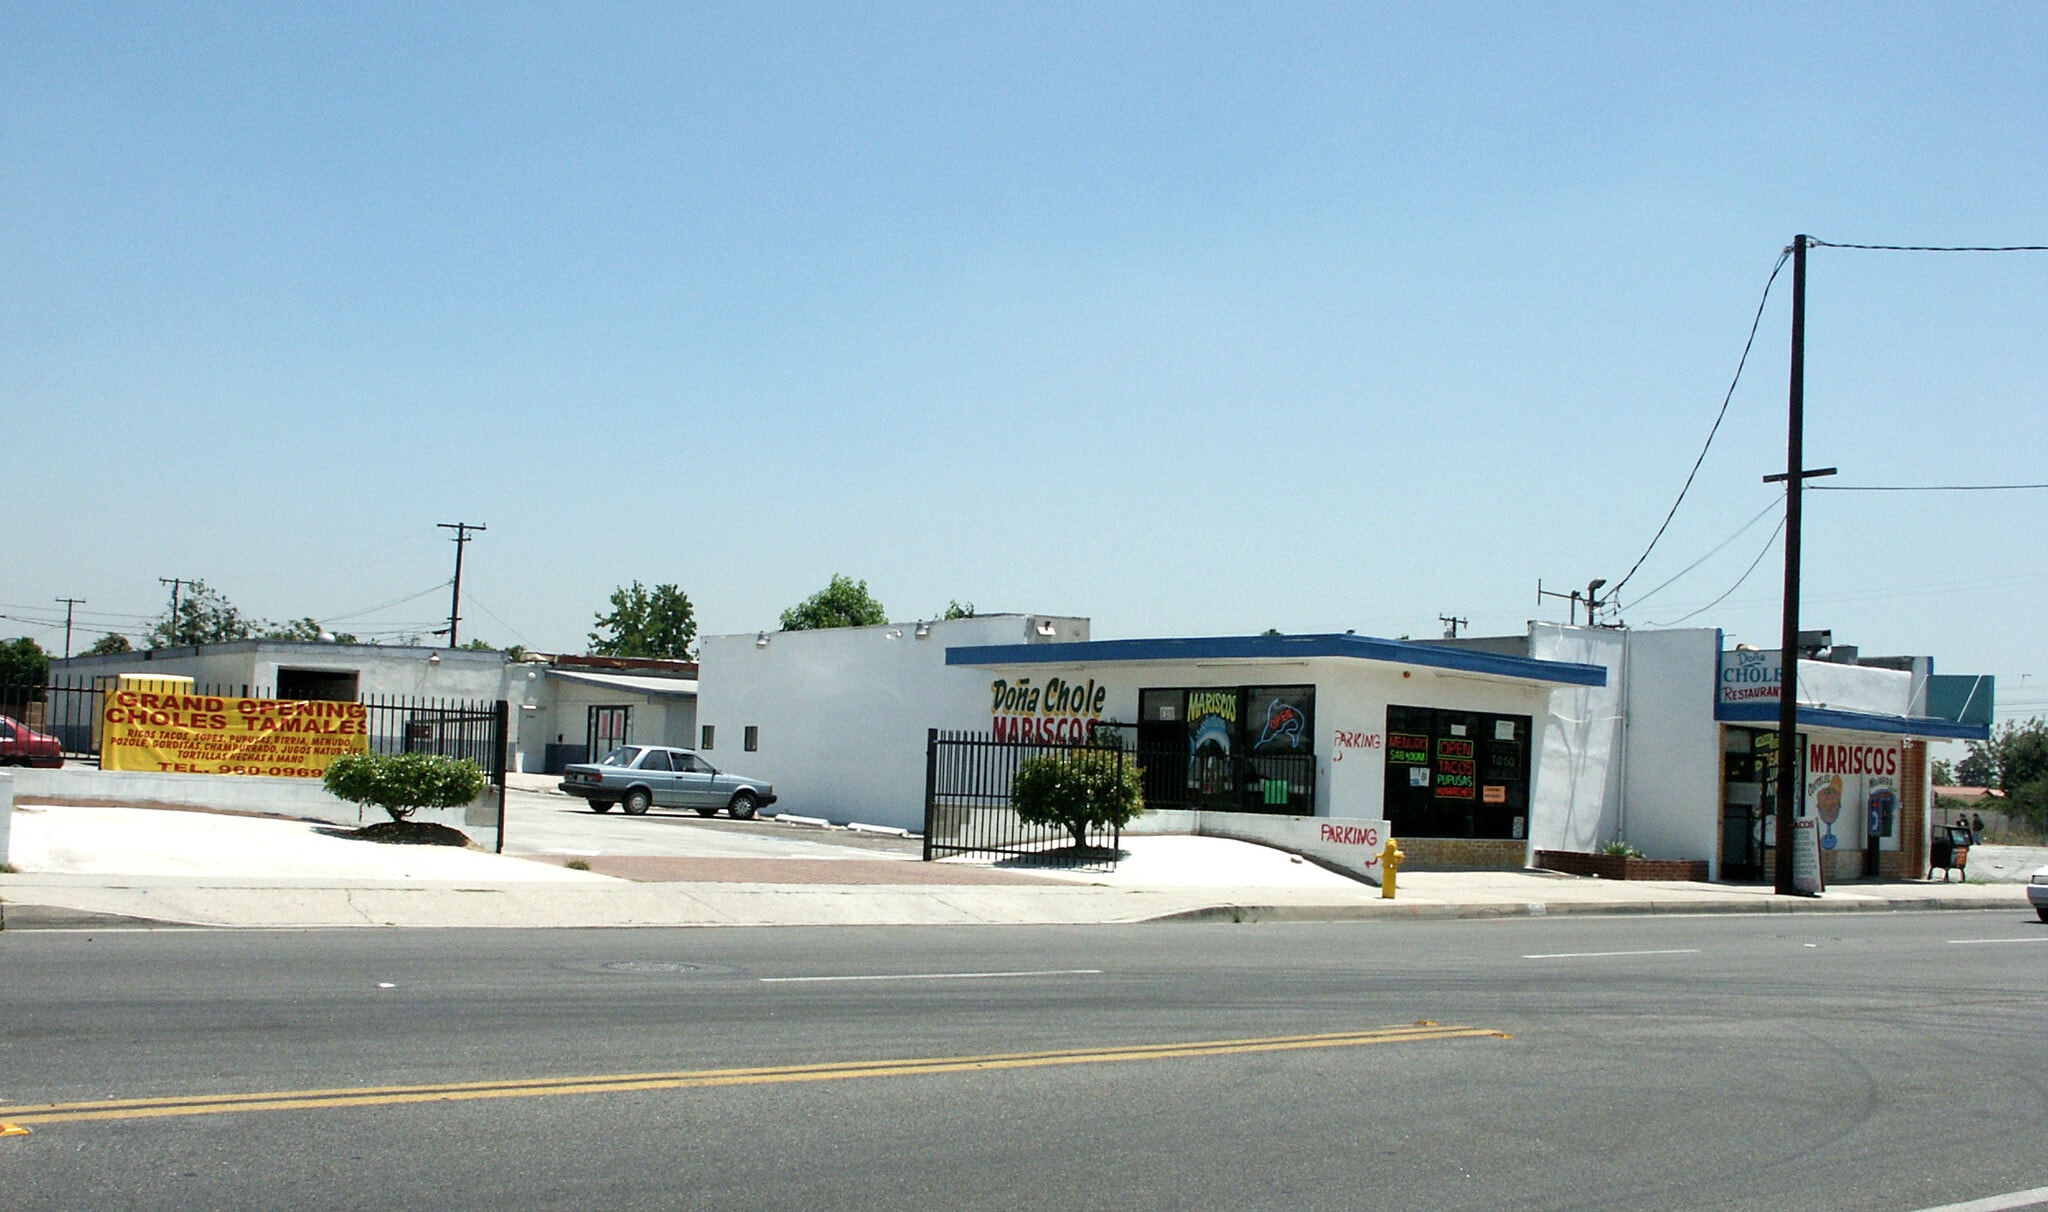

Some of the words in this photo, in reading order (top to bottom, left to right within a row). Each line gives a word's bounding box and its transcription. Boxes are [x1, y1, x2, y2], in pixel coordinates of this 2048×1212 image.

[991, 678, 1040, 716] Doña
[1042, 677, 1106, 717] Chole
[1722, 686, 1782, 701] RESTAURAN
[117, 691, 224, 712] GRAND
[237, 699, 367, 719] OPENING
[1187, 692, 1237, 723] MARISCOS
[106, 708, 227, 730] CHOLES
[242, 716, 367, 735] TAMALES
[128, 729, 157, 738] RICOS
[1333, 730, 1381, 749] PARKING
[281, 746, 311, 755] JUGOS
[1440, 741, 1471, 756] OPEN
[178, 750, 227, 760] TORTILLAS
[230, 753, 265, 762] HECHAS
[267, 754, 274, 762] A
[276, 755, 304, 764] MANO
[1810, 744, 1896, 775] MARISCOS
[157, 762, 210, 774] TEL.
[218, 765, 323, 778] 960-0969
[1438, 760, 1473, 776] TACOS
[1437, 775, 1473, 787] PUPUSAS
[1795, 821, 1814, 829] ACOS
[1321, 823, 1377, 846] PARKING
